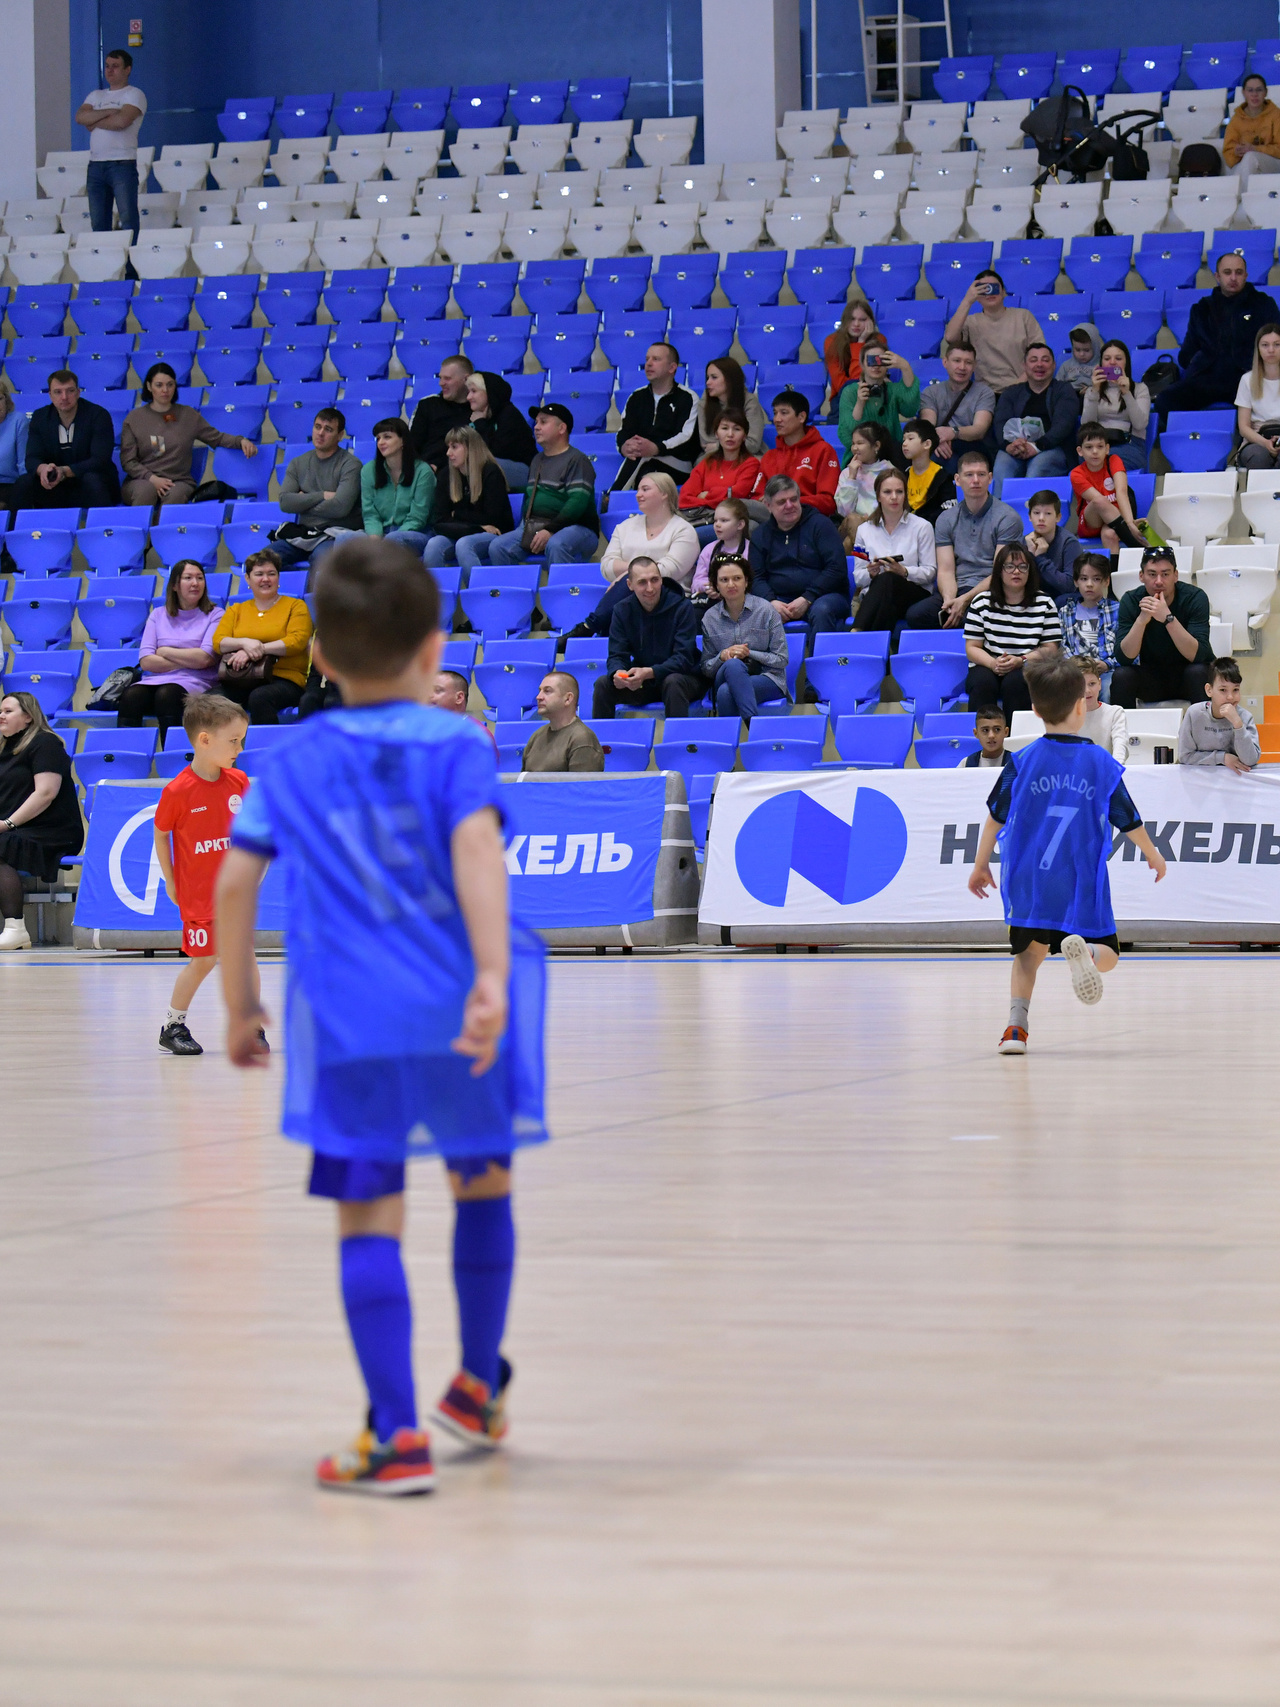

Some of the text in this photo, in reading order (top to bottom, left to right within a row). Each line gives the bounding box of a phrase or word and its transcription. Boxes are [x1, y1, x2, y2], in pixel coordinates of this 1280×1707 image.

[1031, 775, 1097, 801] RONALDO
[1039, 805, 1079, 870] 7
[188, 928, 208, 947] 30
